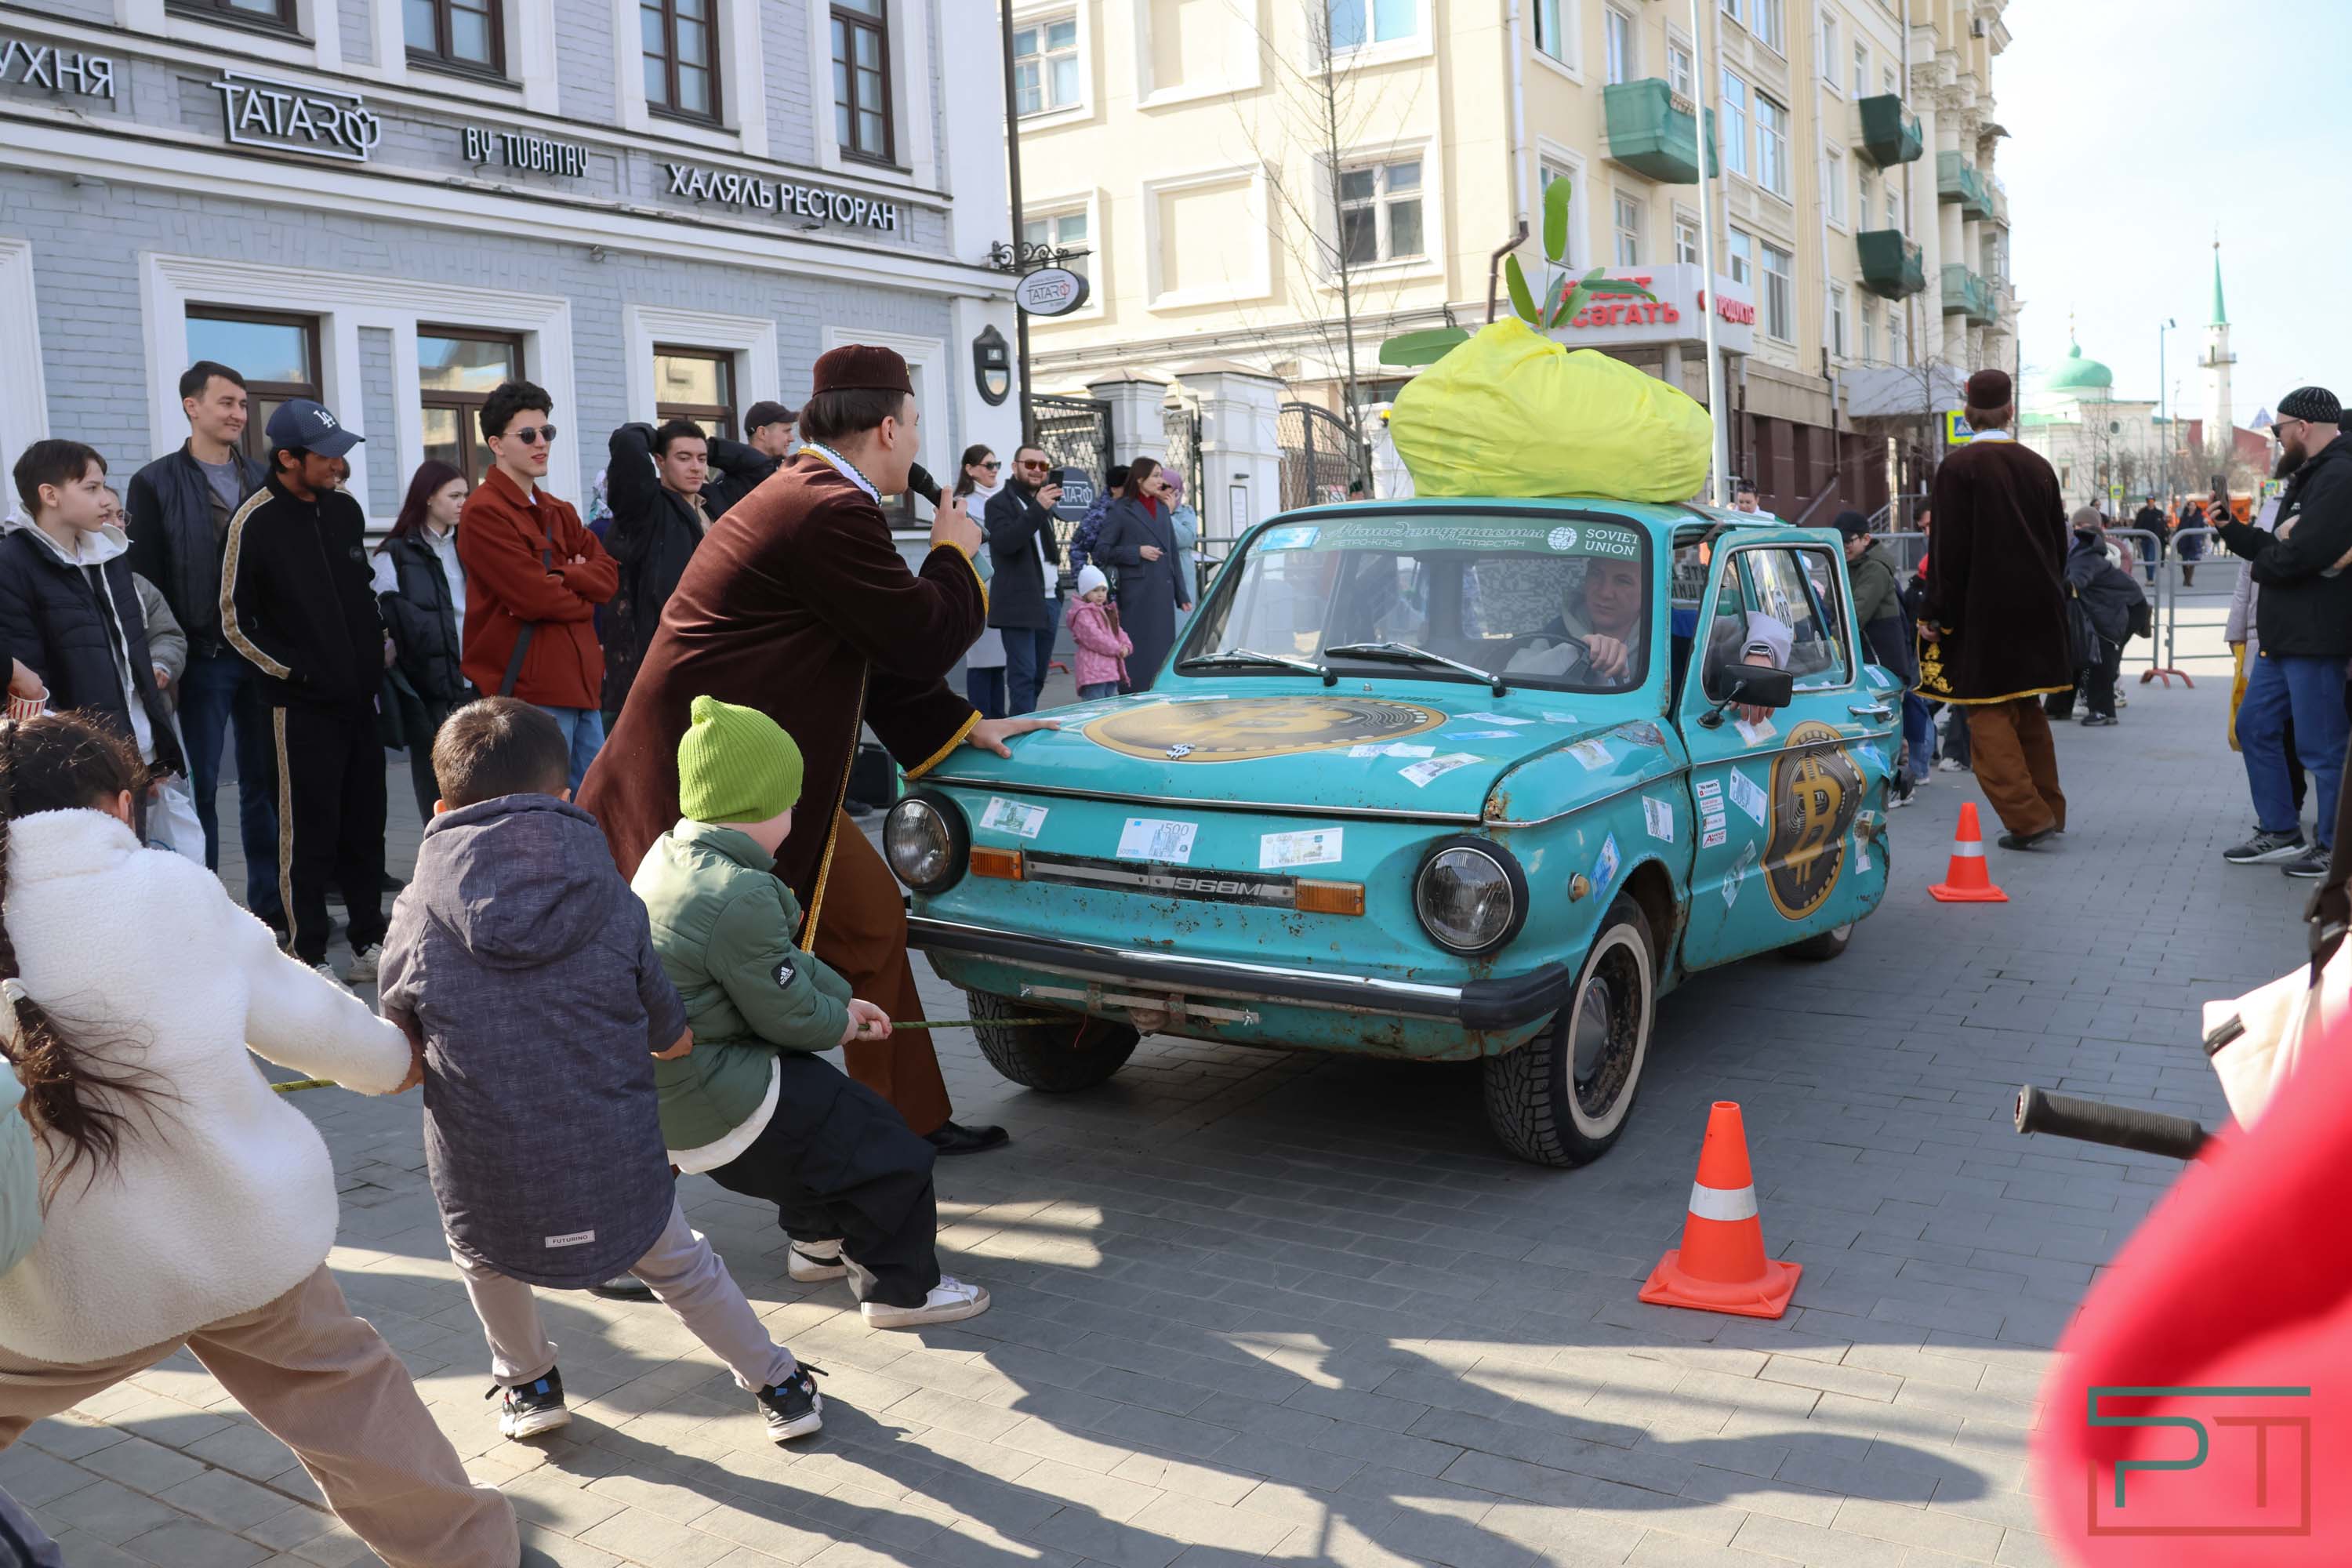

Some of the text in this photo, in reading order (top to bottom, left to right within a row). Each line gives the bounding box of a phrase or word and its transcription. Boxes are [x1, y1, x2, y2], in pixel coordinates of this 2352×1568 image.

[466, 126, 588, 177] BY TUBATAY
[668, 162, 897, 230] ХАЛЯЛЬ РЕСТОРАН
[314, 410, 336, 428] LA
[1457, 539, 1525, 547] ТАТАРСТАН
[1584, 528, 1639, 544] SOVIET
[1584, 543, 1636, 556] UNION
